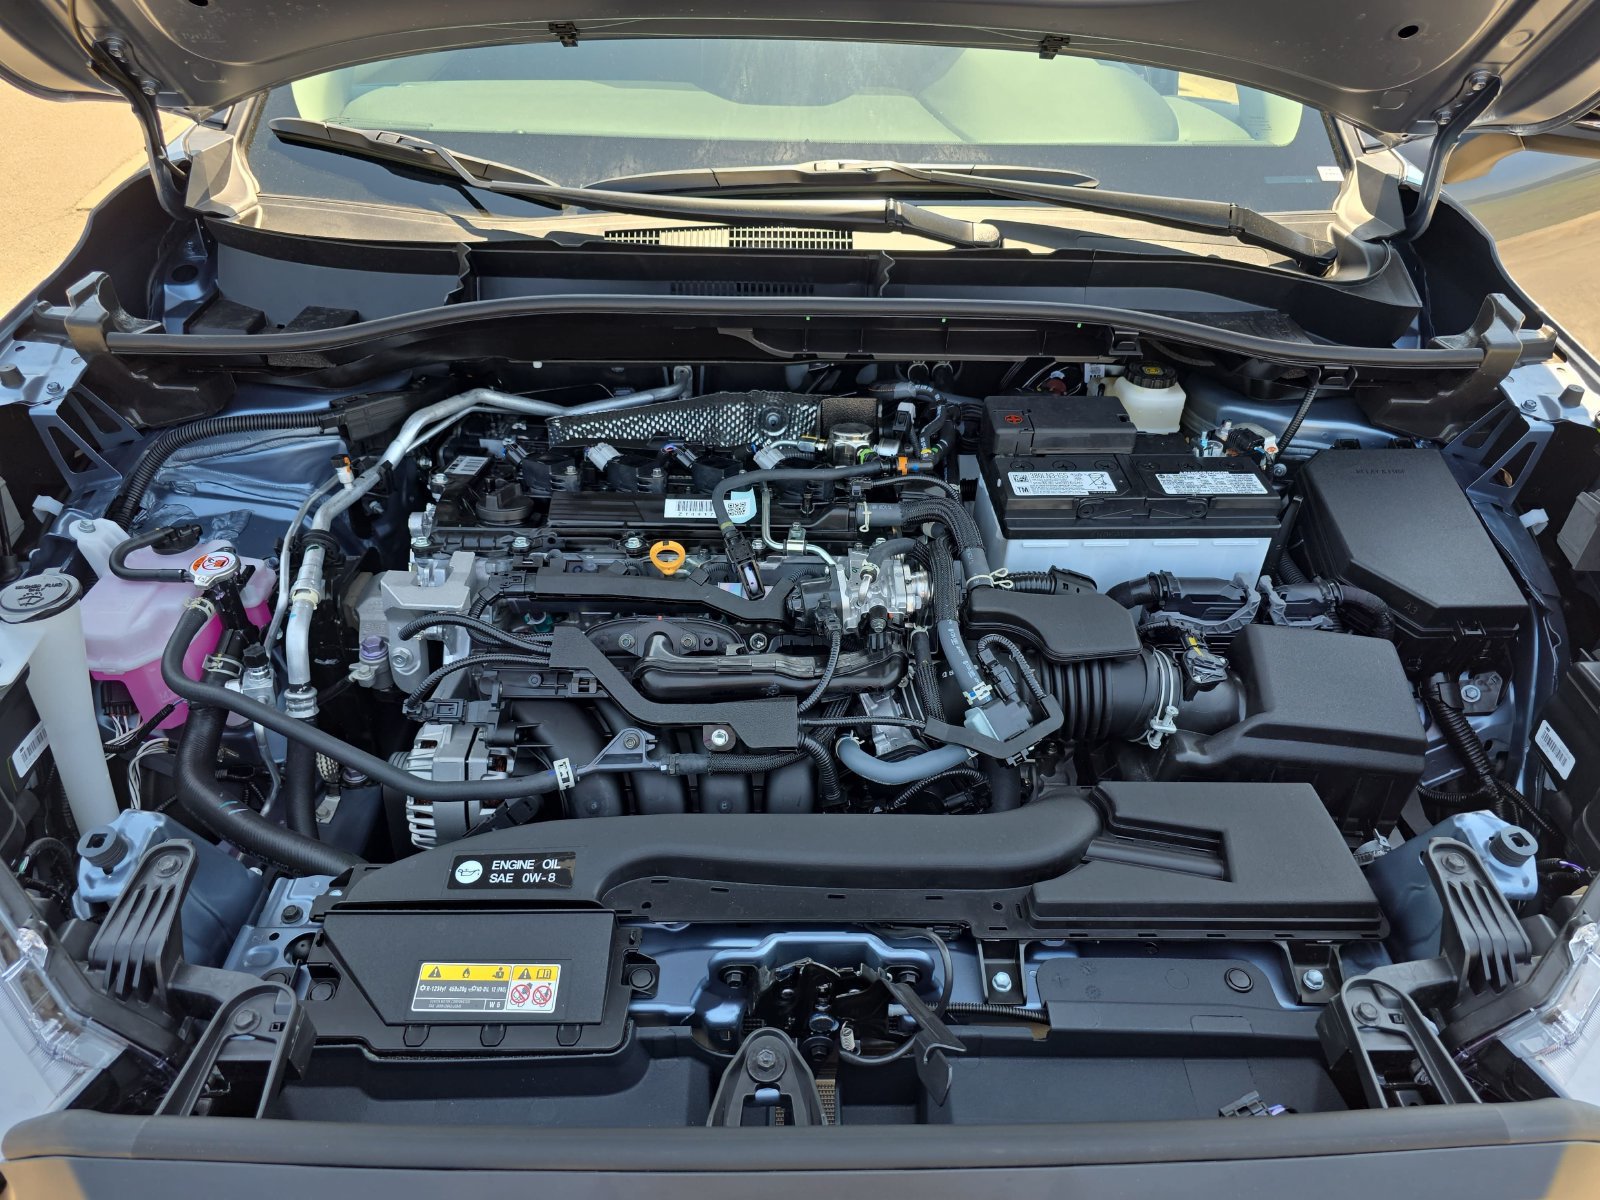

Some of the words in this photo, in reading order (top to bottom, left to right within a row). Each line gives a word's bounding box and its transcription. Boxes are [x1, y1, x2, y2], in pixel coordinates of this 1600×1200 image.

[491, 859, 536, 870] ENGINE
[542, 858, 561, 869] OIL
[489, 872, 514, 883] SAE
[521, 872, 556, 883] 0W-8
